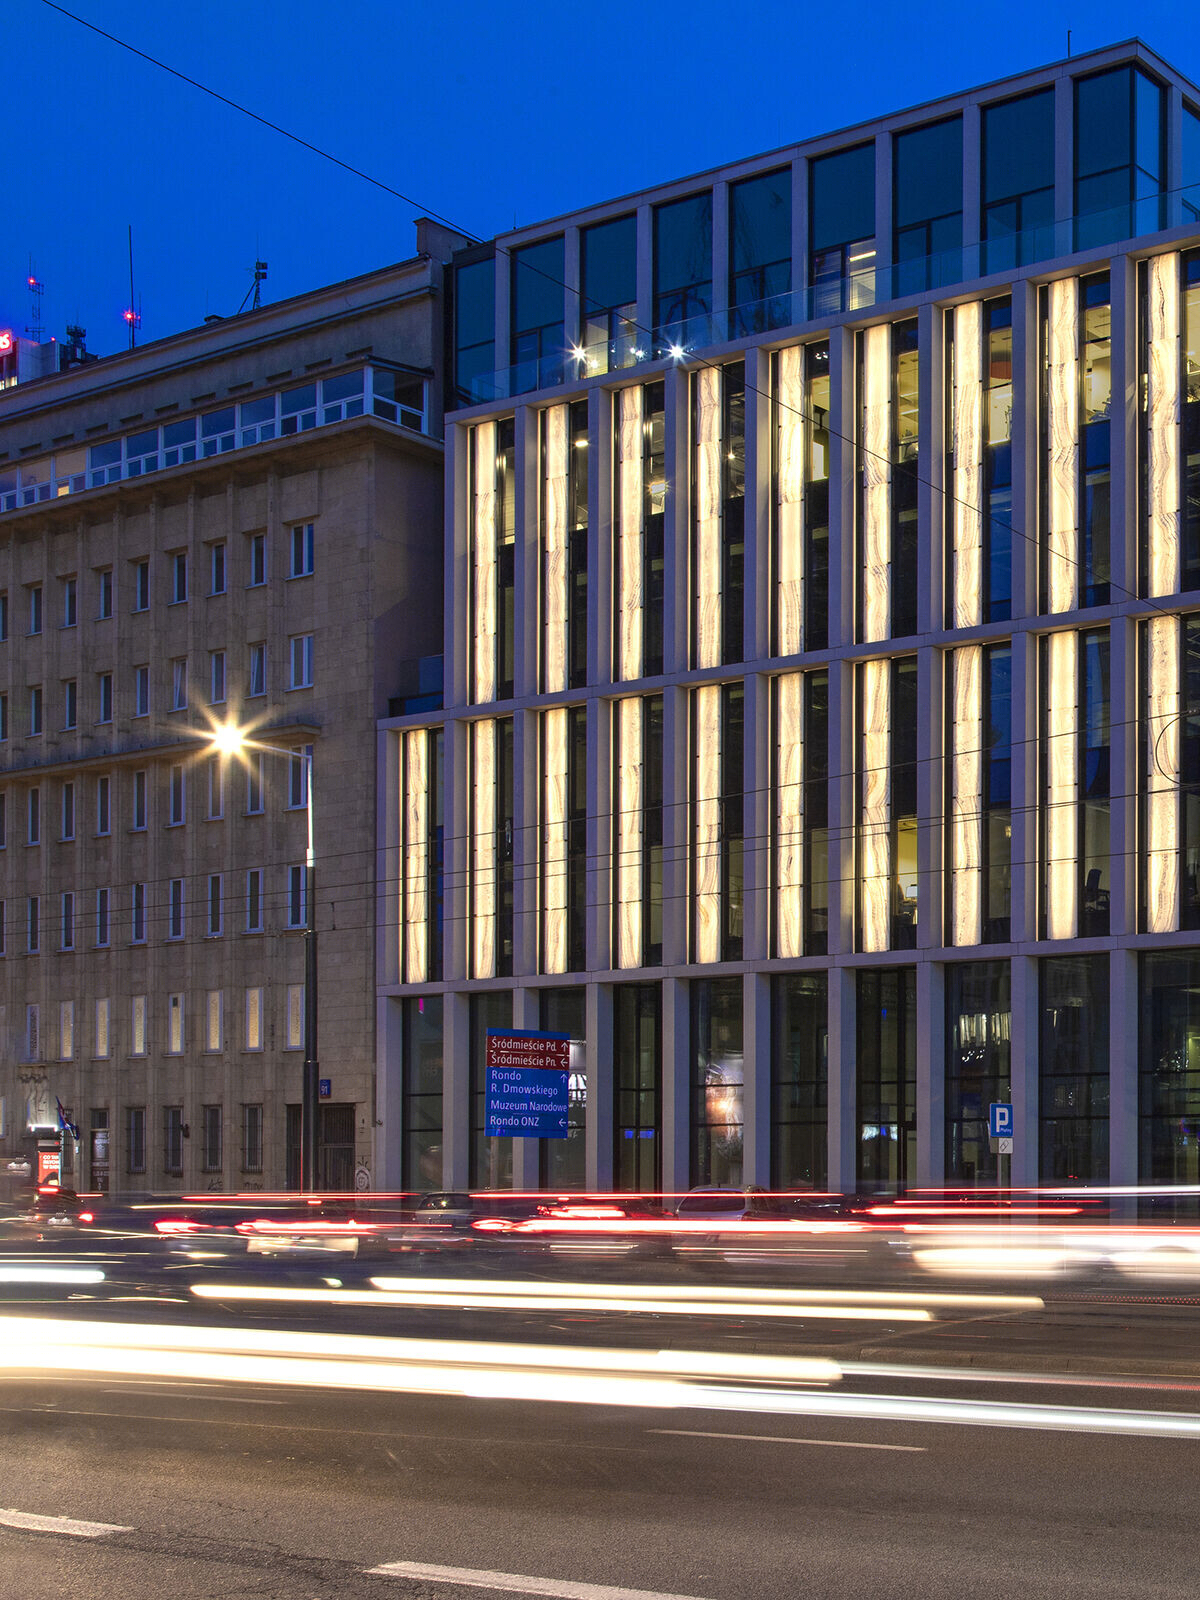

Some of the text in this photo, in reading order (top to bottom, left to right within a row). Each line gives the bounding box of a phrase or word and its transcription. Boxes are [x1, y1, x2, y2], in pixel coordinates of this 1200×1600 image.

[491, 1036, 557, 1051] Śródmieście Pd.
[491, 1052, 556, 1067] Śródmieście Pn.
[491, 1070, 522, 1081] Rondo
[490, 1083, 558, 1098] R. Dmowskiego
[490, 1100, 568, 1113] Muzeum Narodowe
[490, 1115, 540, 1127] Rondo ONZ
[995, 1107, 1009, 1133] P
